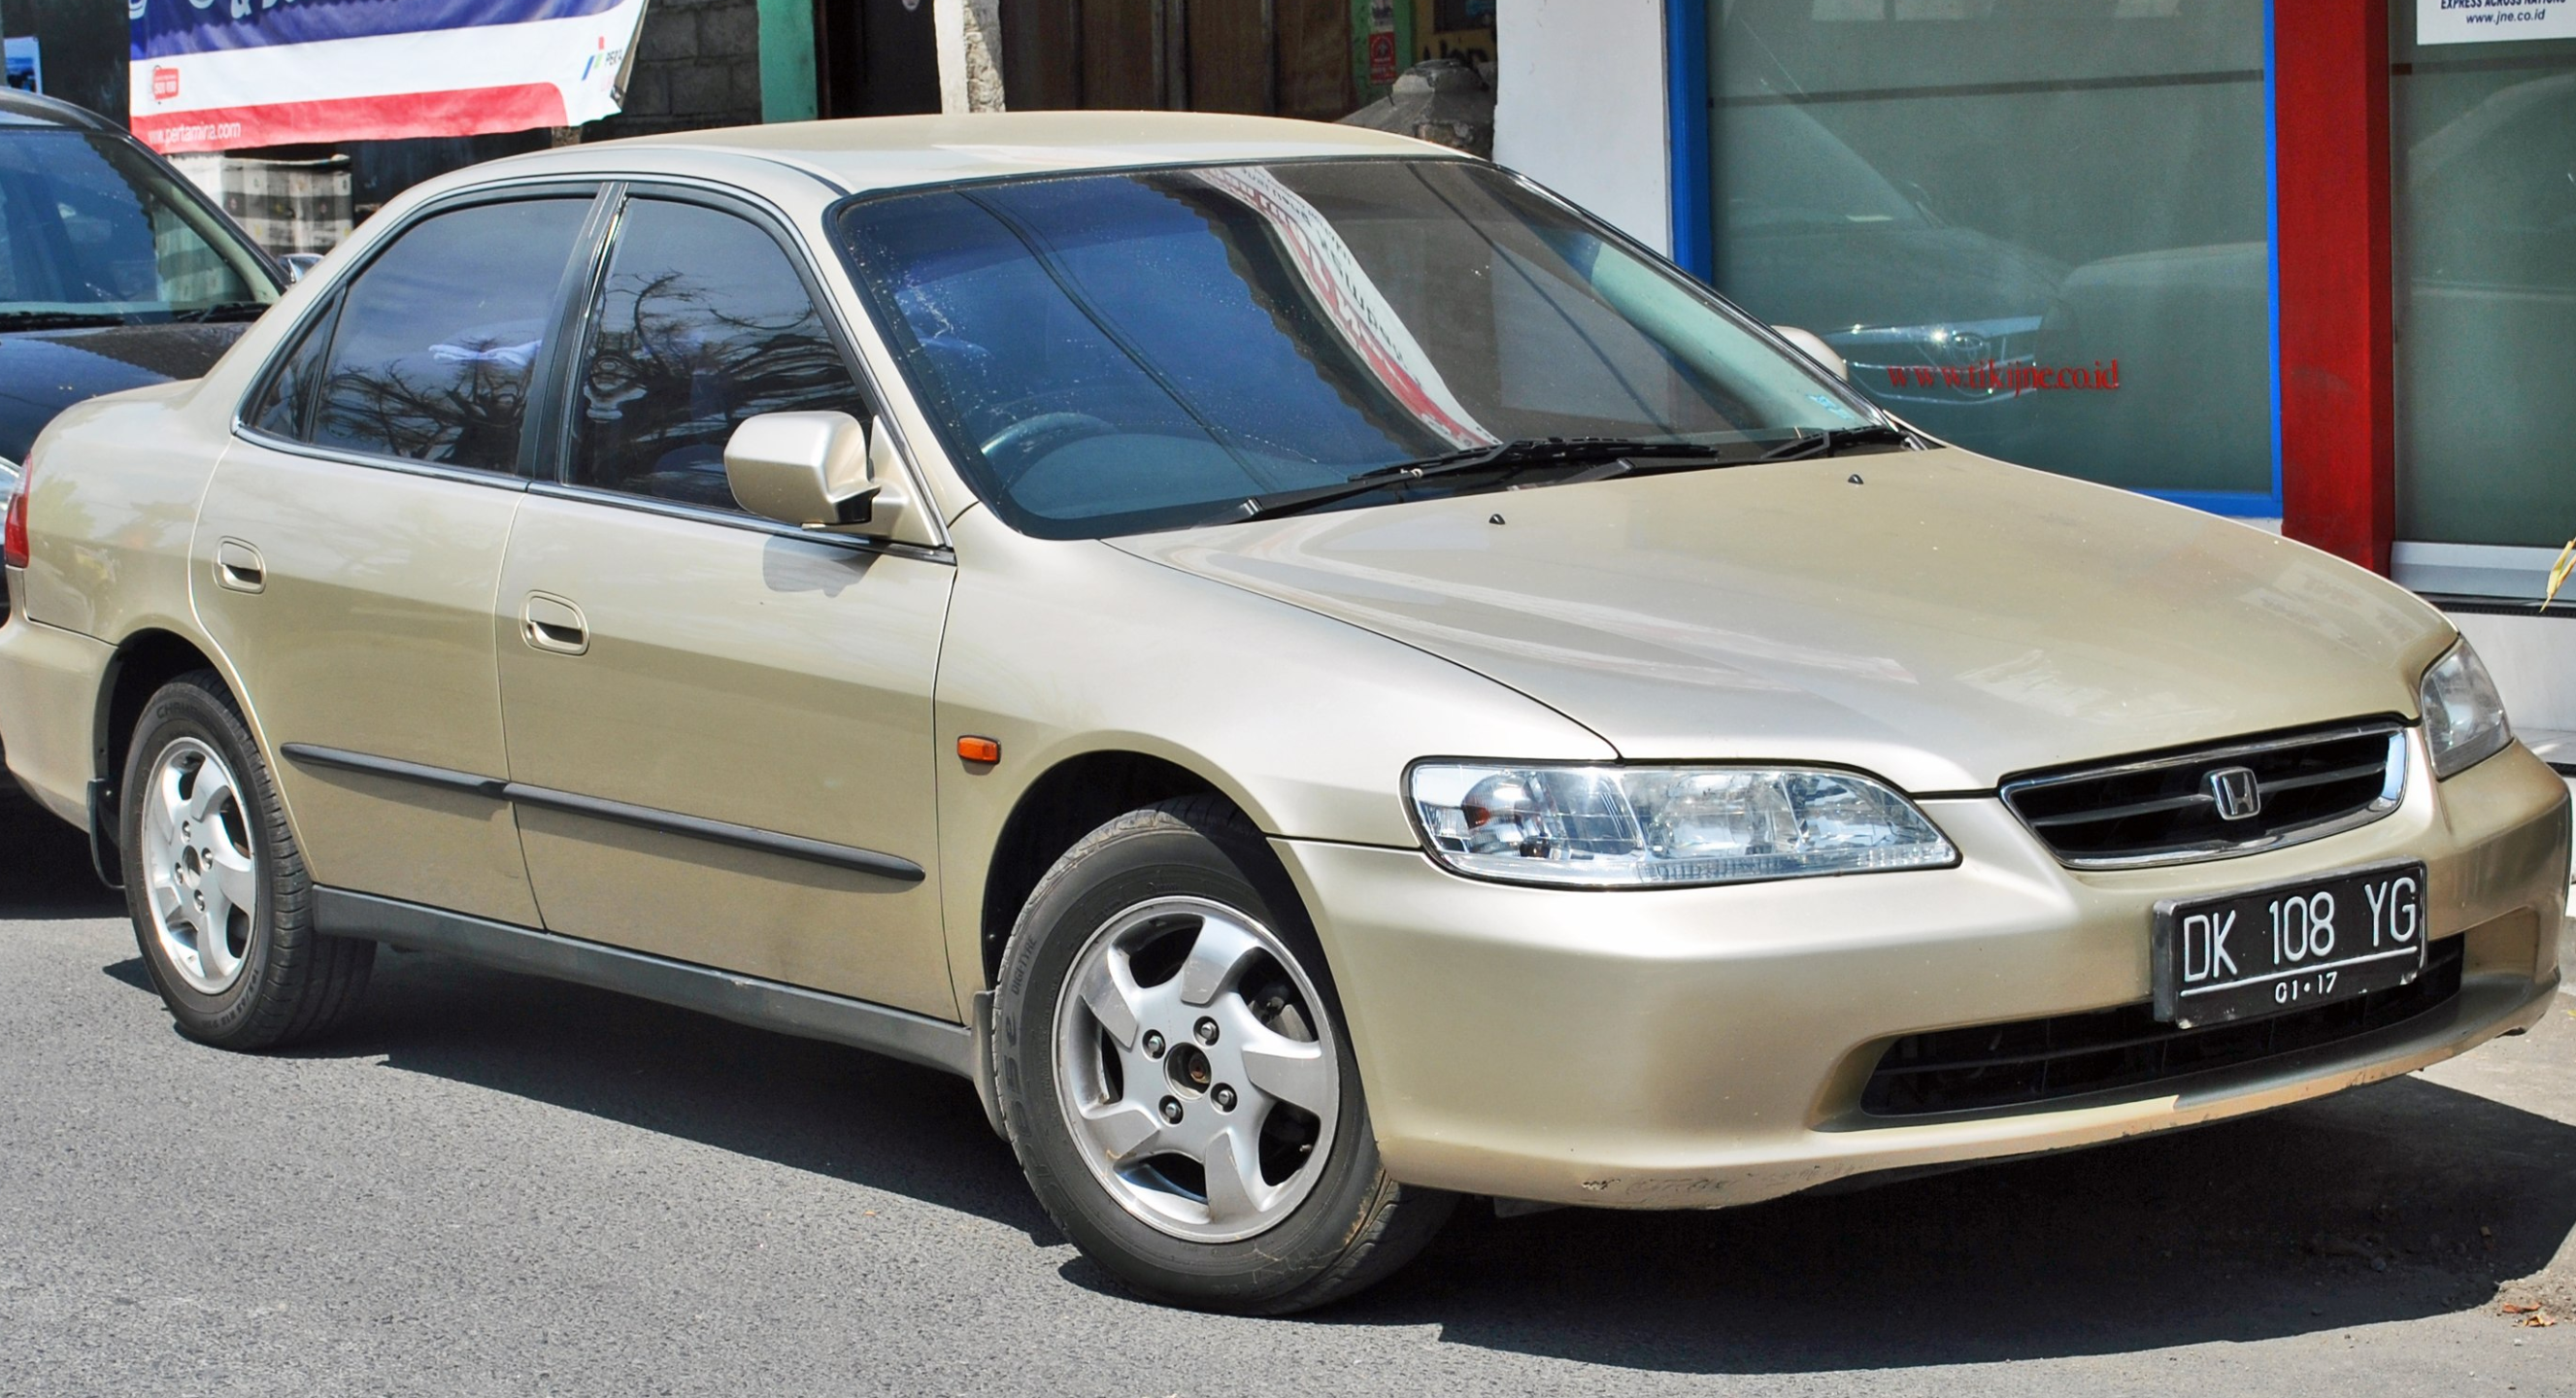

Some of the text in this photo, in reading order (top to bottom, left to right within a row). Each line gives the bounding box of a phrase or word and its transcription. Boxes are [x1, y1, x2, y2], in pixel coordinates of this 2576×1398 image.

[2466, 9, 2546, 25] www.jne.co.id
[1887, 358, 2119, 398] www.tikijne.co.id
[2184, 876, 2417, 982] DK 108 YG
